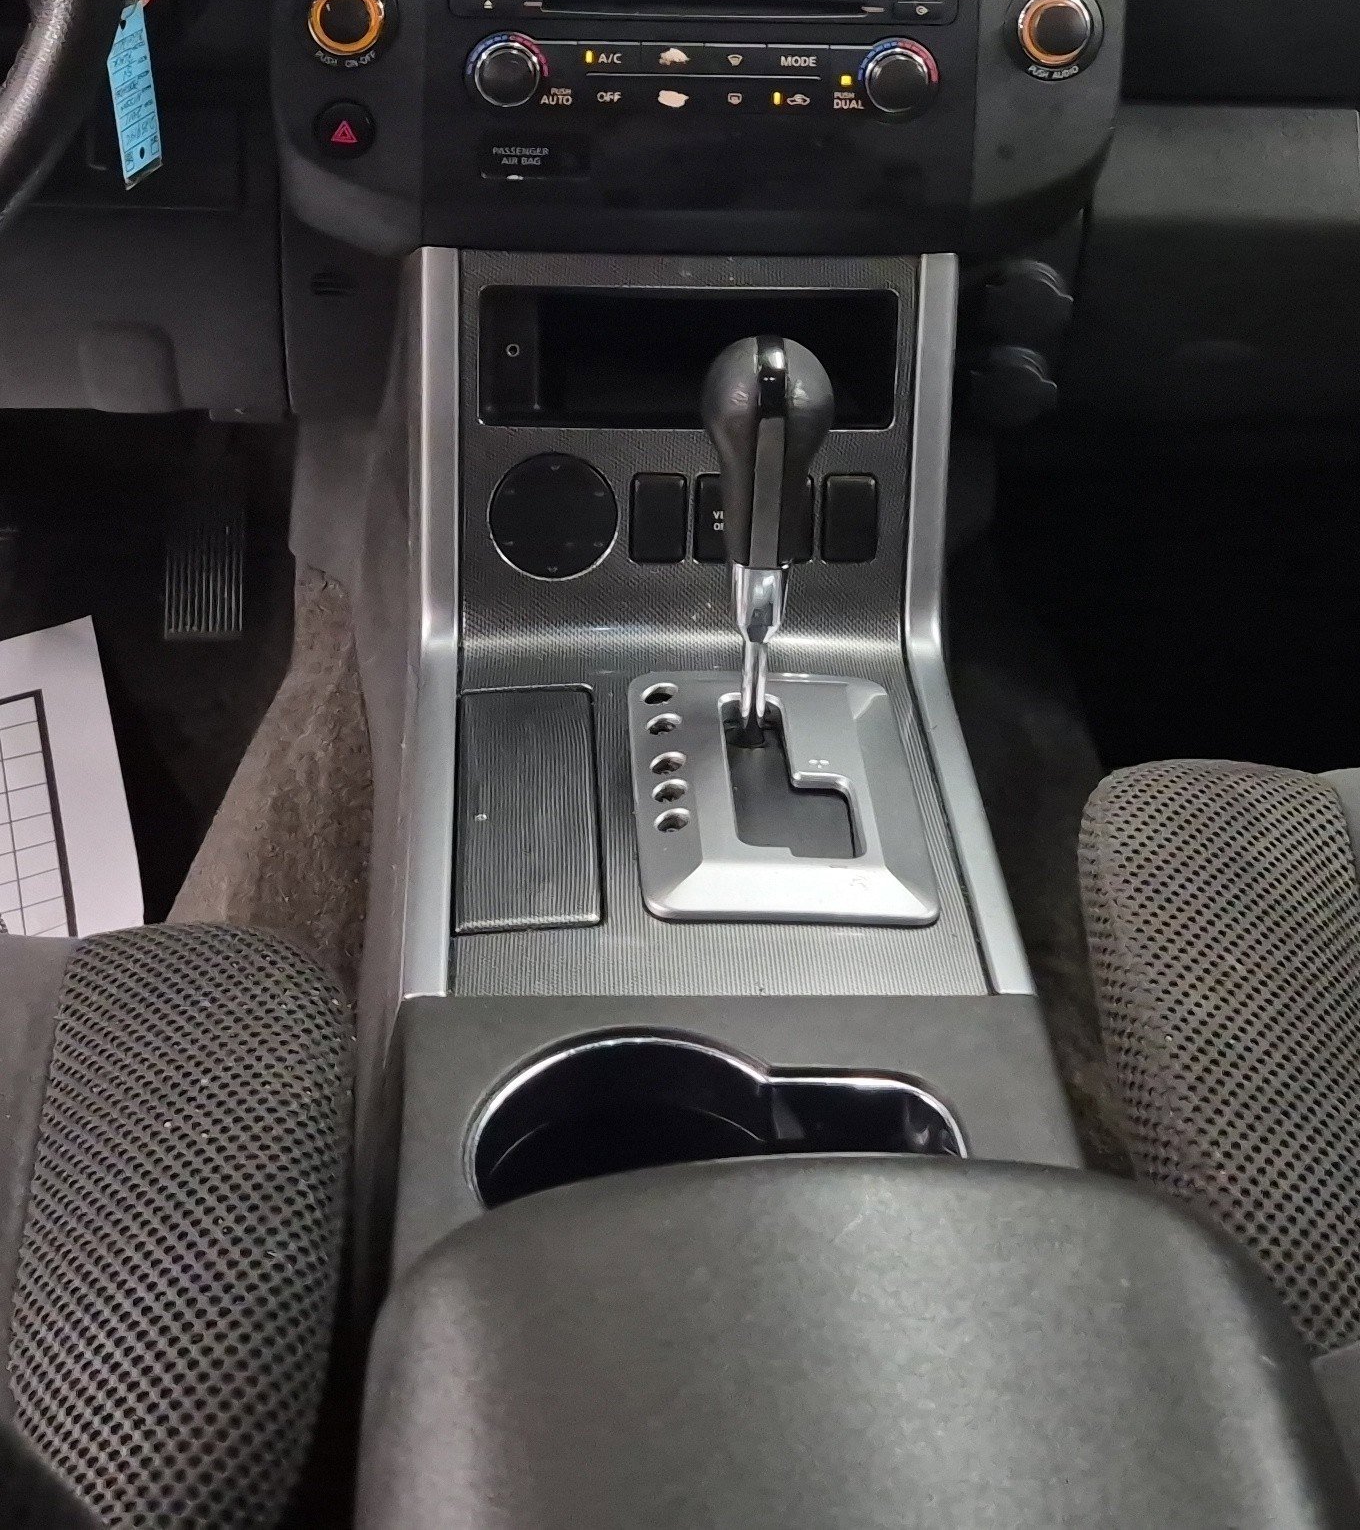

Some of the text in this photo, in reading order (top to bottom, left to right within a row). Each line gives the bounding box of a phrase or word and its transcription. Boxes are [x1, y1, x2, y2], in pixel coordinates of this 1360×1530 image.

[597, 53, 622, 64] A/C
[780, 55, 818, 68] MODE
[1027, 66, 1079, 79] PUSH AUDIO
[550, 87, 572, 95] PUSH
[833, 92, 855, 100] PUSH
[540, 95, 573, 106] AUTO
[596, 91, 622, 103] OFF
[833, 99, 865, 110] DUAL
[492, 146, 550, 156] PASSENGER
[501, 157, 541, 166] AIR BAG
